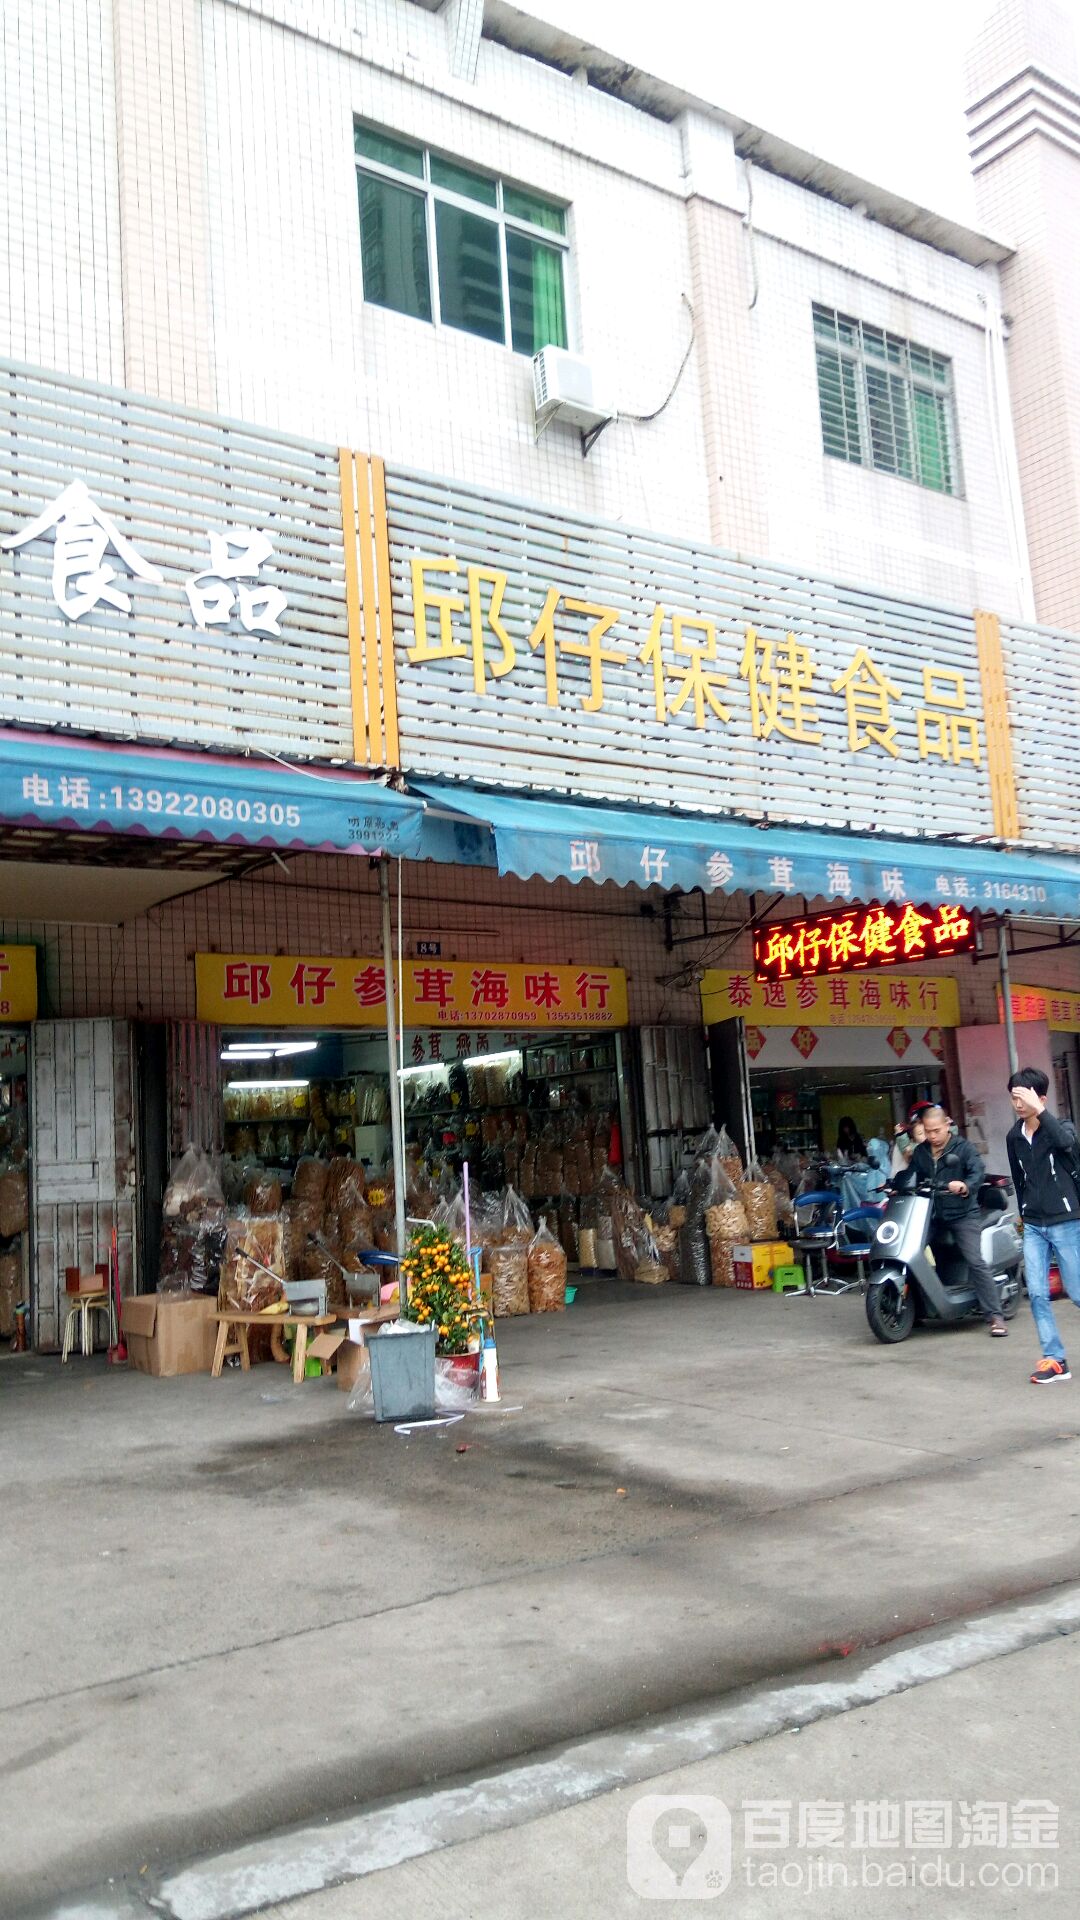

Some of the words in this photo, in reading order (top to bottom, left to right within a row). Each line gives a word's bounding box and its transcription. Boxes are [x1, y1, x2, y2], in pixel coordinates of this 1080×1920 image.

[1, 477, 289, 637] 食品
[406, 557, 982, 768] 邱仔保健食品
[569, 839, 907, 900] 邱仔参茸海味
[763, 903, 971, 974] 邱仔保健食品
[222, 961, 612, 1009] 邱仔参茸海味行
[728, 974, 940, 1011] 泰逸参茸海味行
